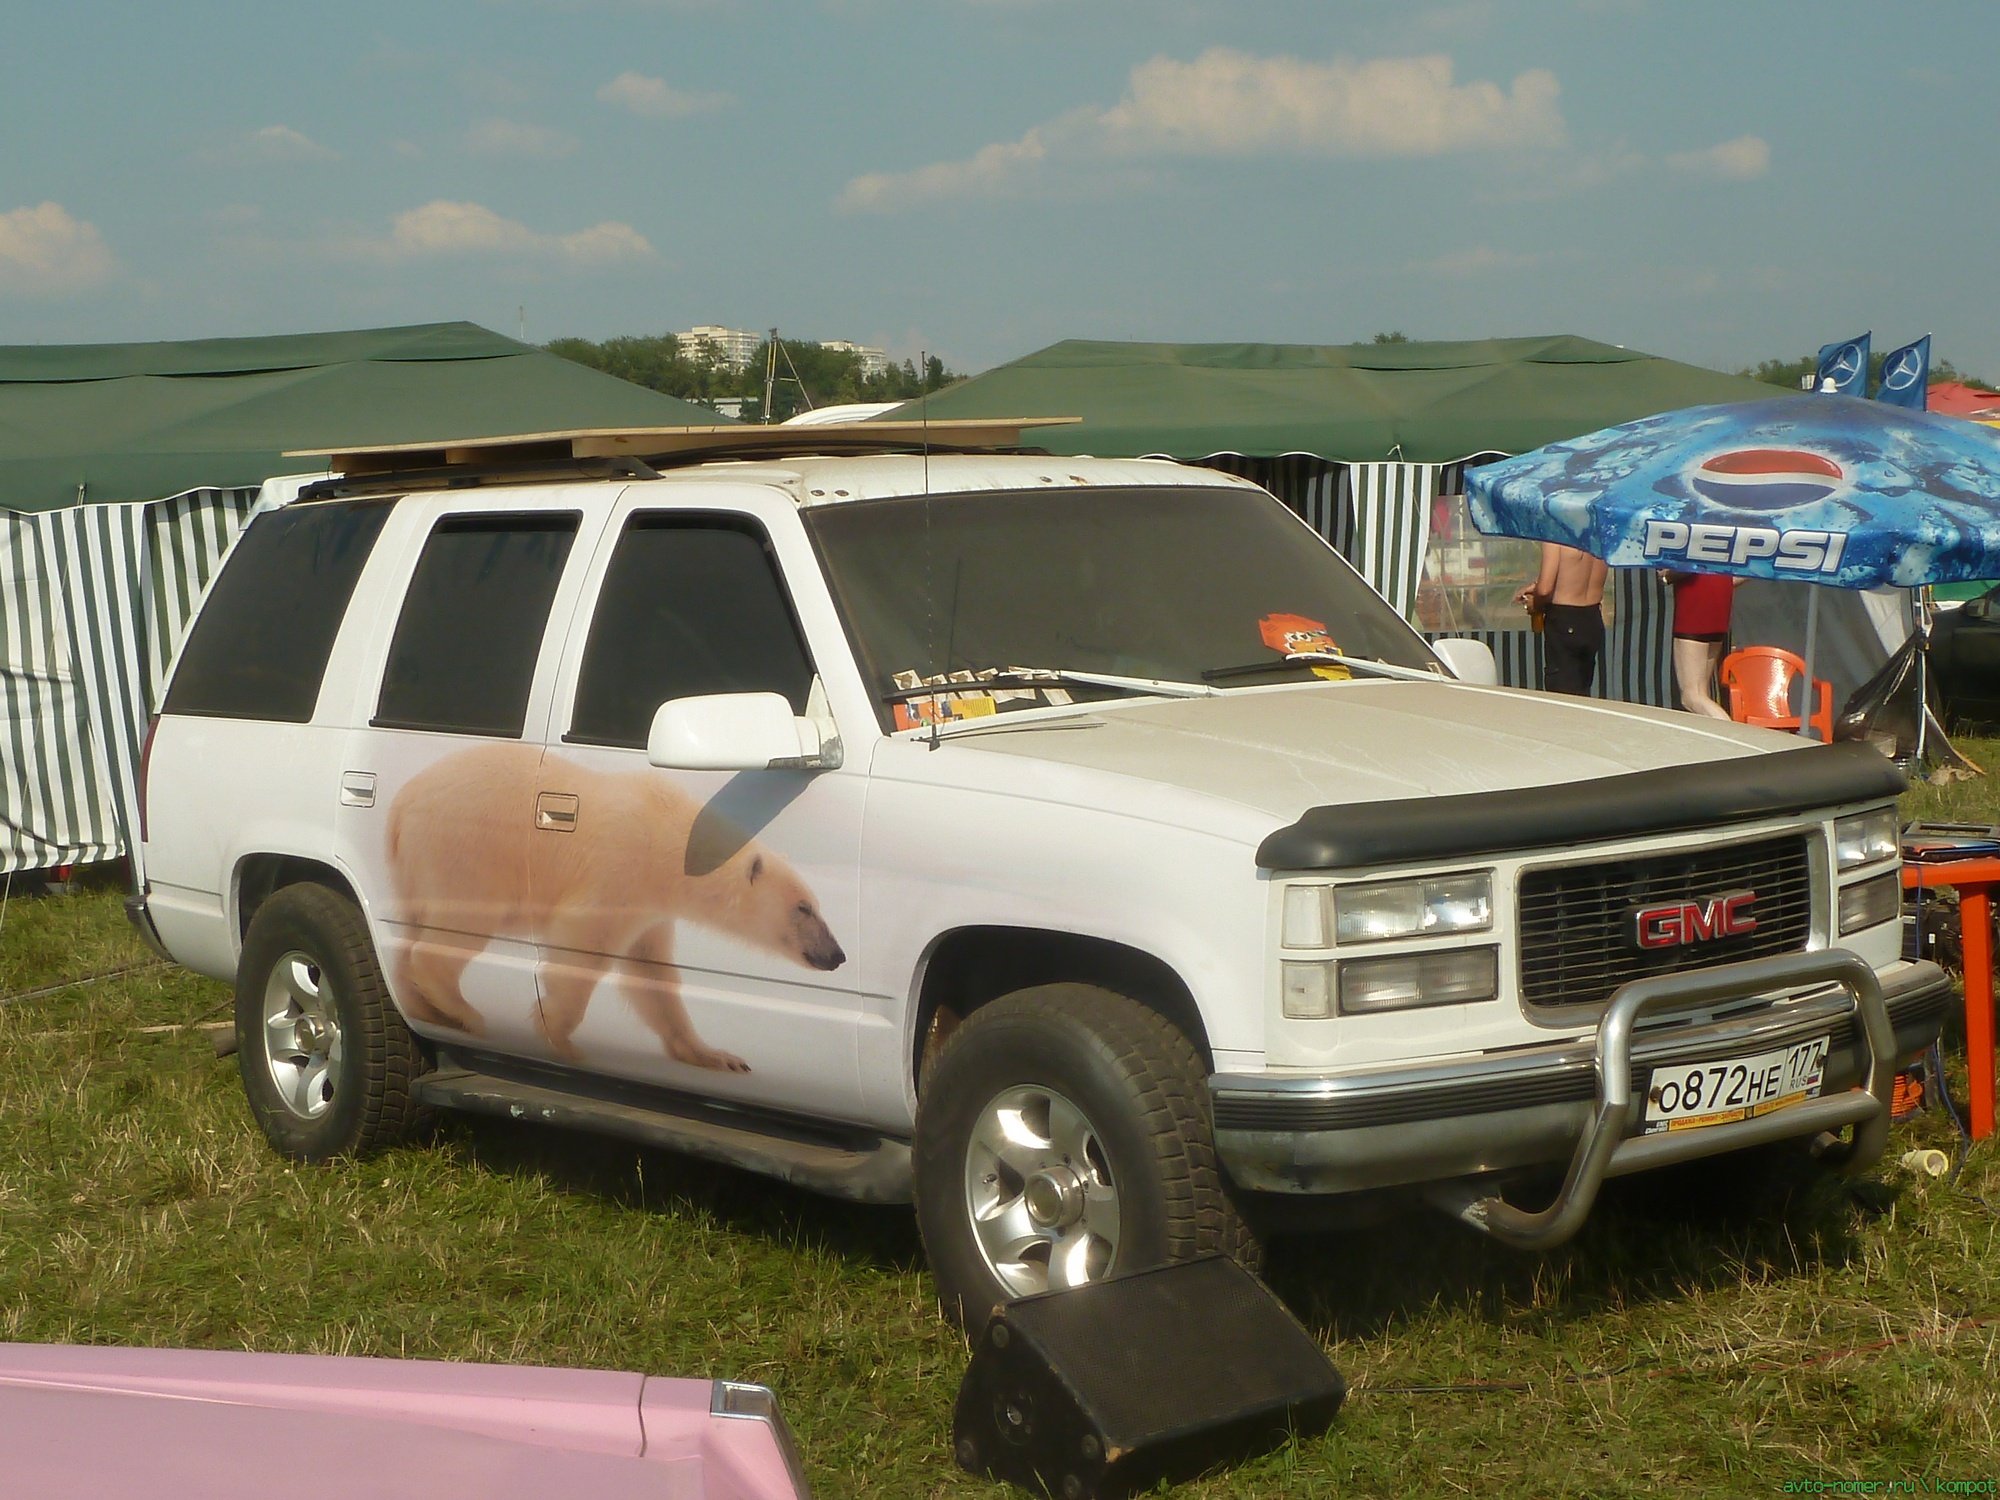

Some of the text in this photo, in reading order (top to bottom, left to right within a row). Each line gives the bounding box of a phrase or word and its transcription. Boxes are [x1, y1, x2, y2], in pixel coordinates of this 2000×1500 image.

[1643, 520, 1848, 574] PEPSI
[1636, 890, 1757, 950] GMC
[1788, 1041, 1823, 1079] 177
[1790, 1075, 1808, 1089] RUS
